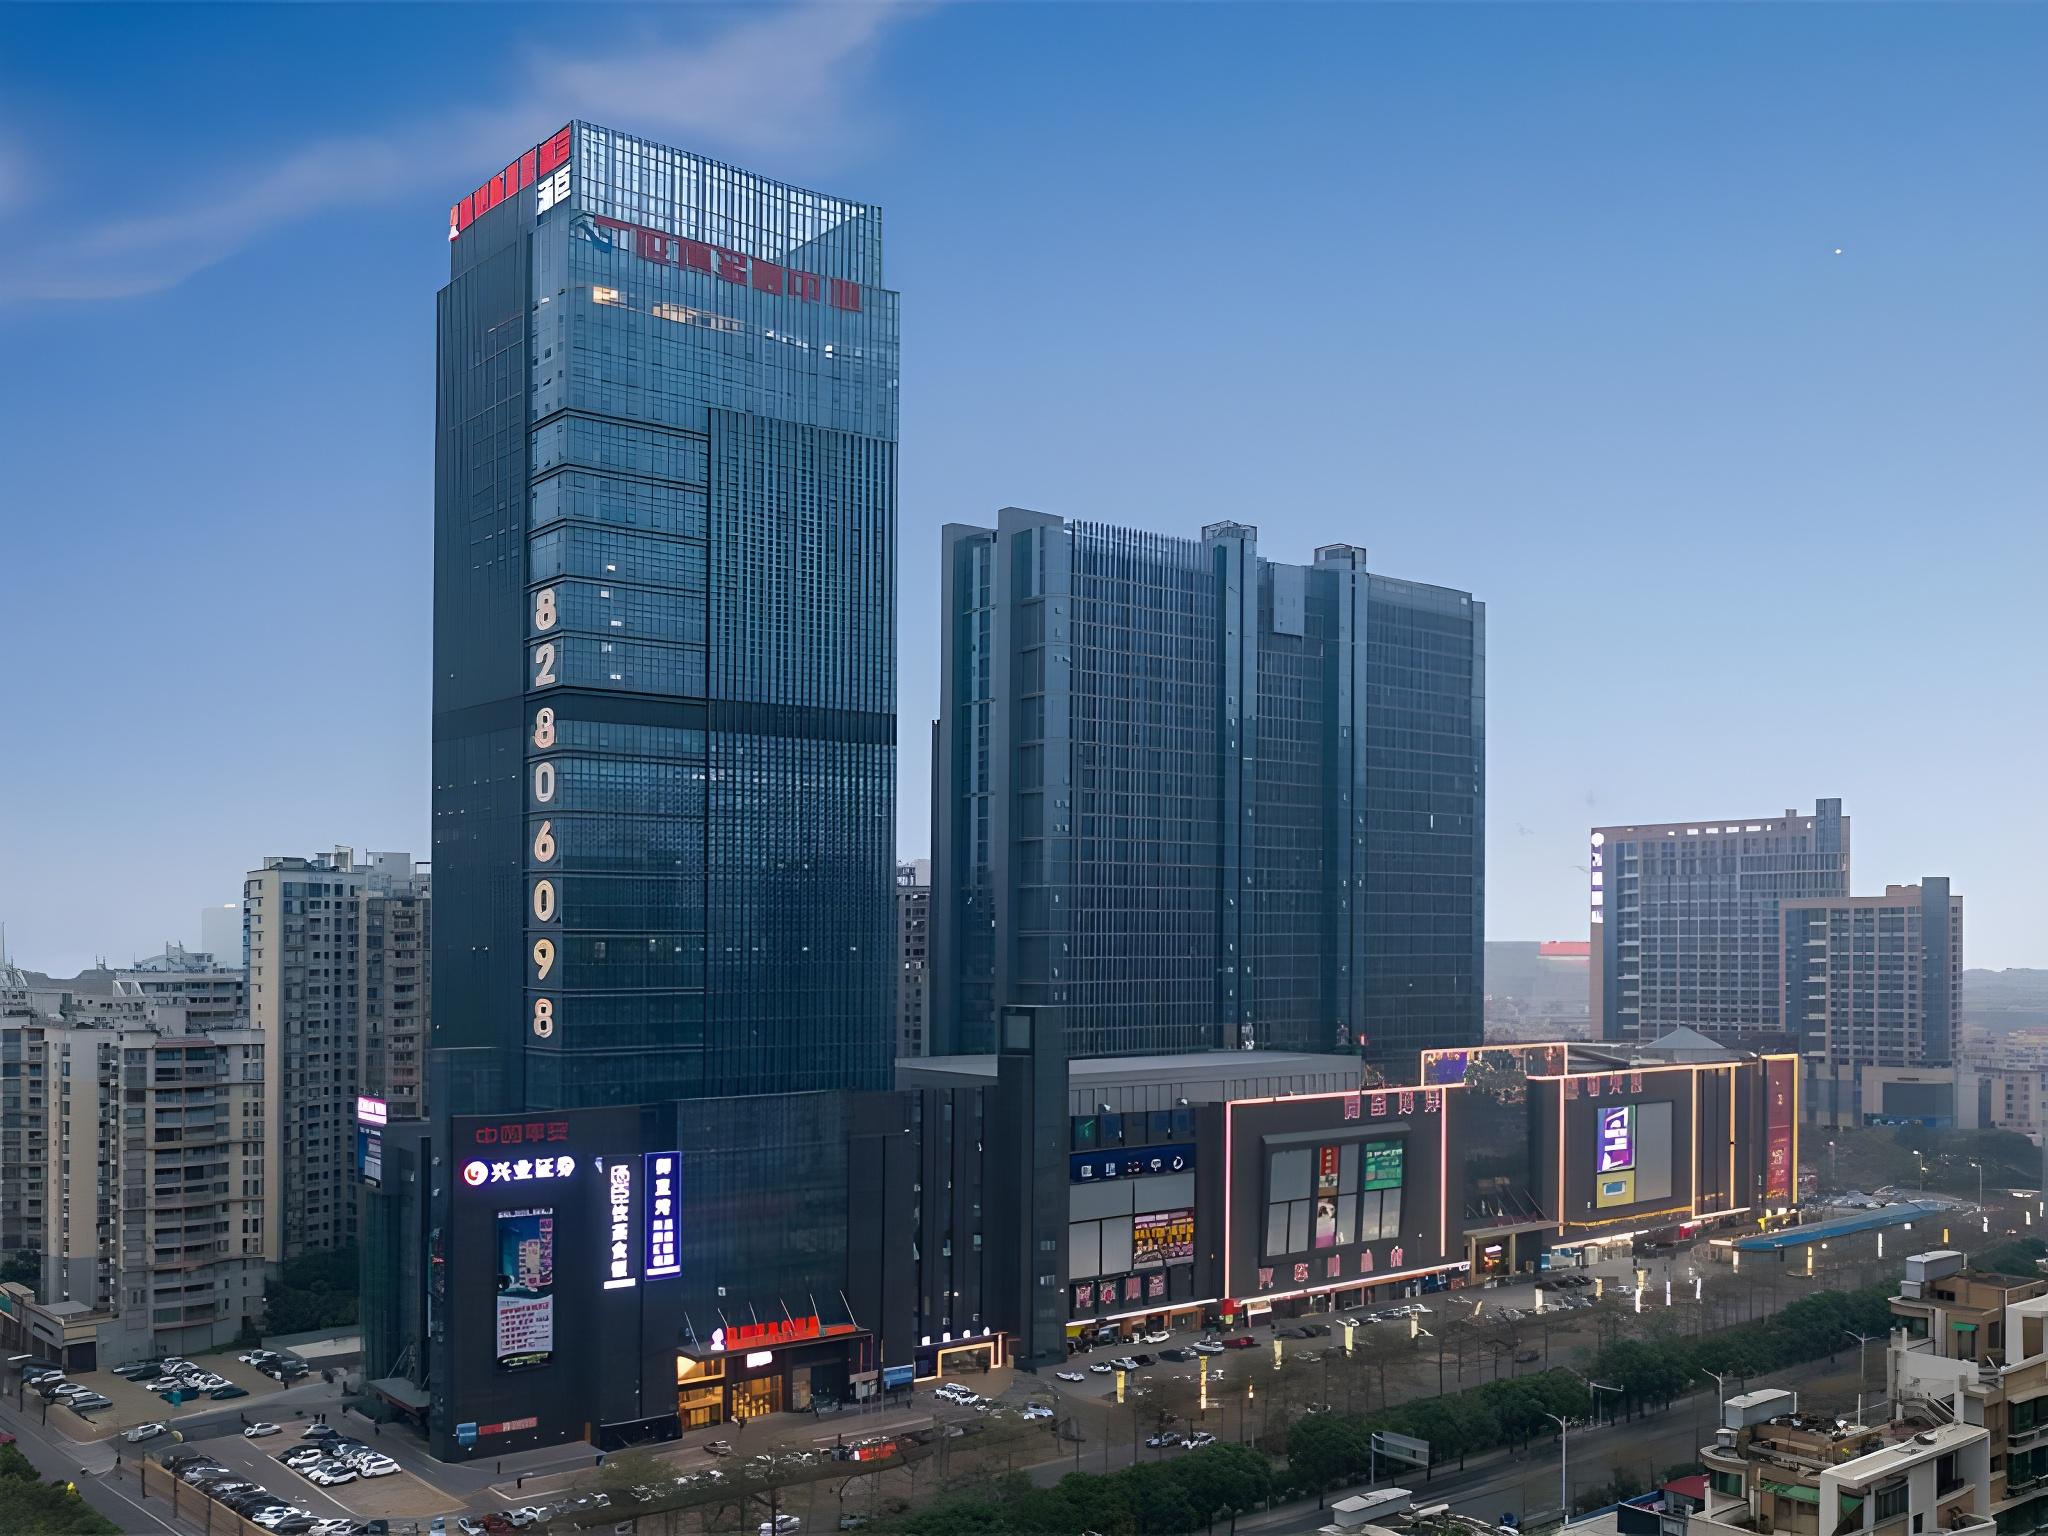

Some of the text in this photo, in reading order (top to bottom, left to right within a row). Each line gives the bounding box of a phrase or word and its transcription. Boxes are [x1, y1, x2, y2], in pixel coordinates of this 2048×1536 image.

[533, 587, 557, 1039] 82806098
[491, 1155, 576, 1183] 兴业证券
